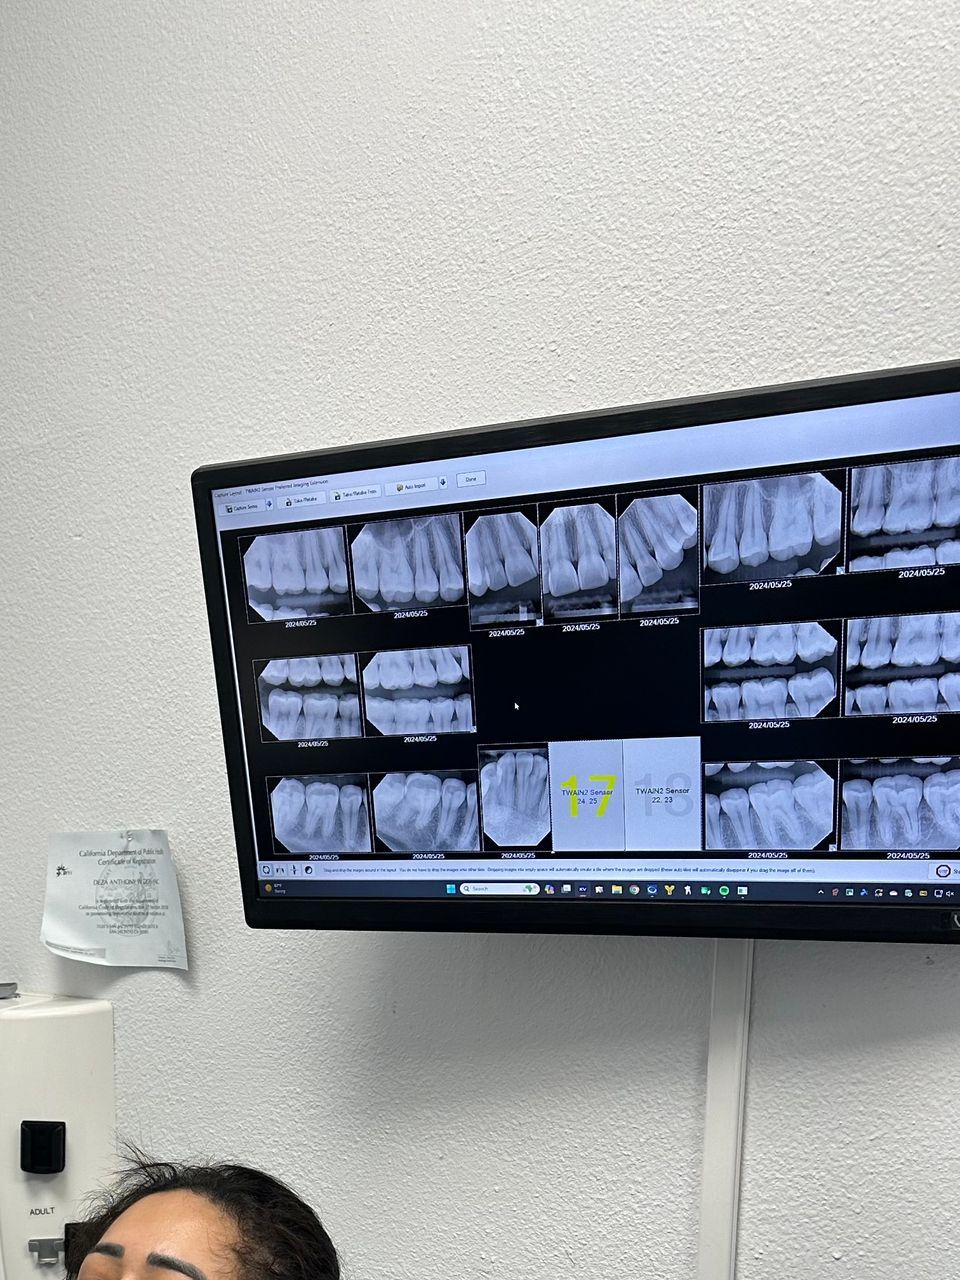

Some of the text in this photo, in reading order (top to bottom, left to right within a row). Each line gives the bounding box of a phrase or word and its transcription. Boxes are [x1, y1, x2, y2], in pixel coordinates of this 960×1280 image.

[898, 568, 946, 578] 2024/05/25
[749, 580, 792, 590] 2024/05/25
[393, 610, 428, 619] 2024/05/25
[285, 620, 317, 628] 2024/05/25
[640, 617, 680, 626] 2024/05/25
[562, 624, 600, 632] 2024/05/25
[488, 629, 525, 638] 2024/05/25
[892, 715, 938, 724] 2024/05/25
[748, 720, 790, 730] 2024/05/25
[298, 740, 328, 748] 2024/05/25
[560, 775, 617, 817] 17
[634, 772, 693, 816] 18
[665, 796, 674, 804] 23
[107, 849, 136, 858] Department
[501, 852, 536, 860] 2024/05/25
[886, 852, 930, 860] 2024/05/25
[30, 1207, 55, 1216] ADULT
